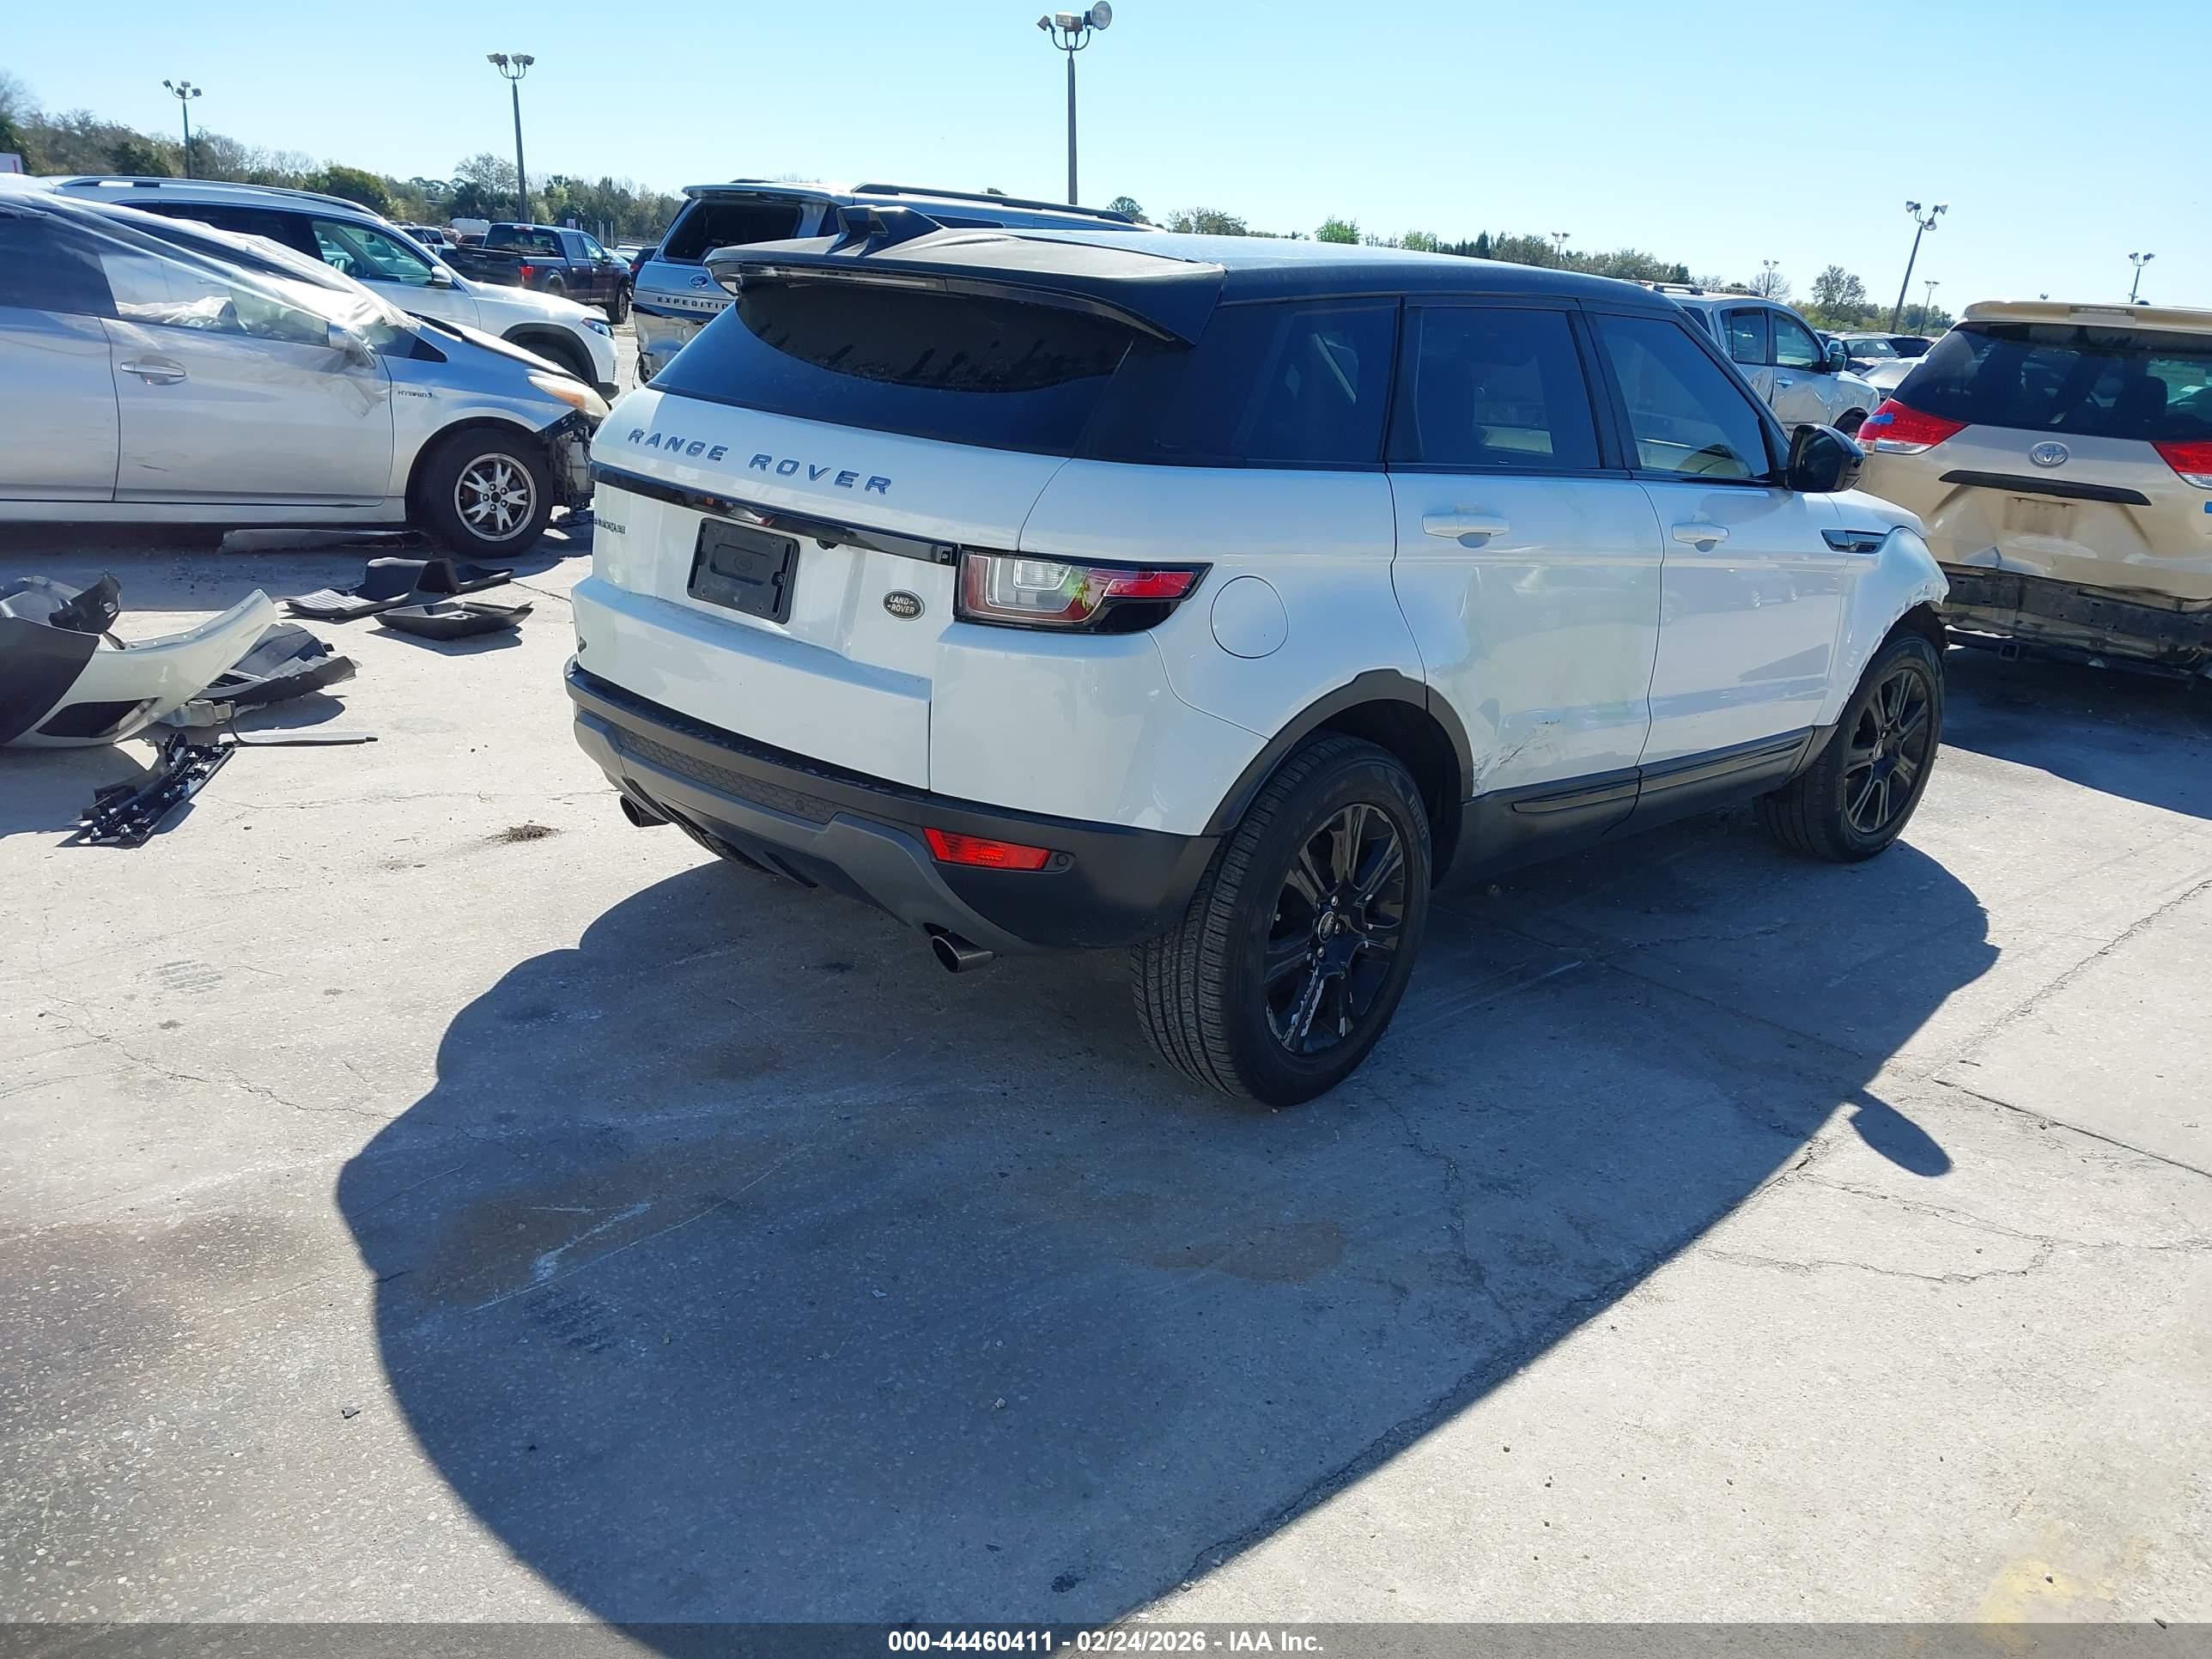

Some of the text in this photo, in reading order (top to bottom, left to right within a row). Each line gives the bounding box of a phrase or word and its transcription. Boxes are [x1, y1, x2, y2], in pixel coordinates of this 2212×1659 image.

[627, 428, 892, 495] RANGE ROVER
[889, 595, 910, 605] LAND
[890, 603, 915, 615] ROVER
